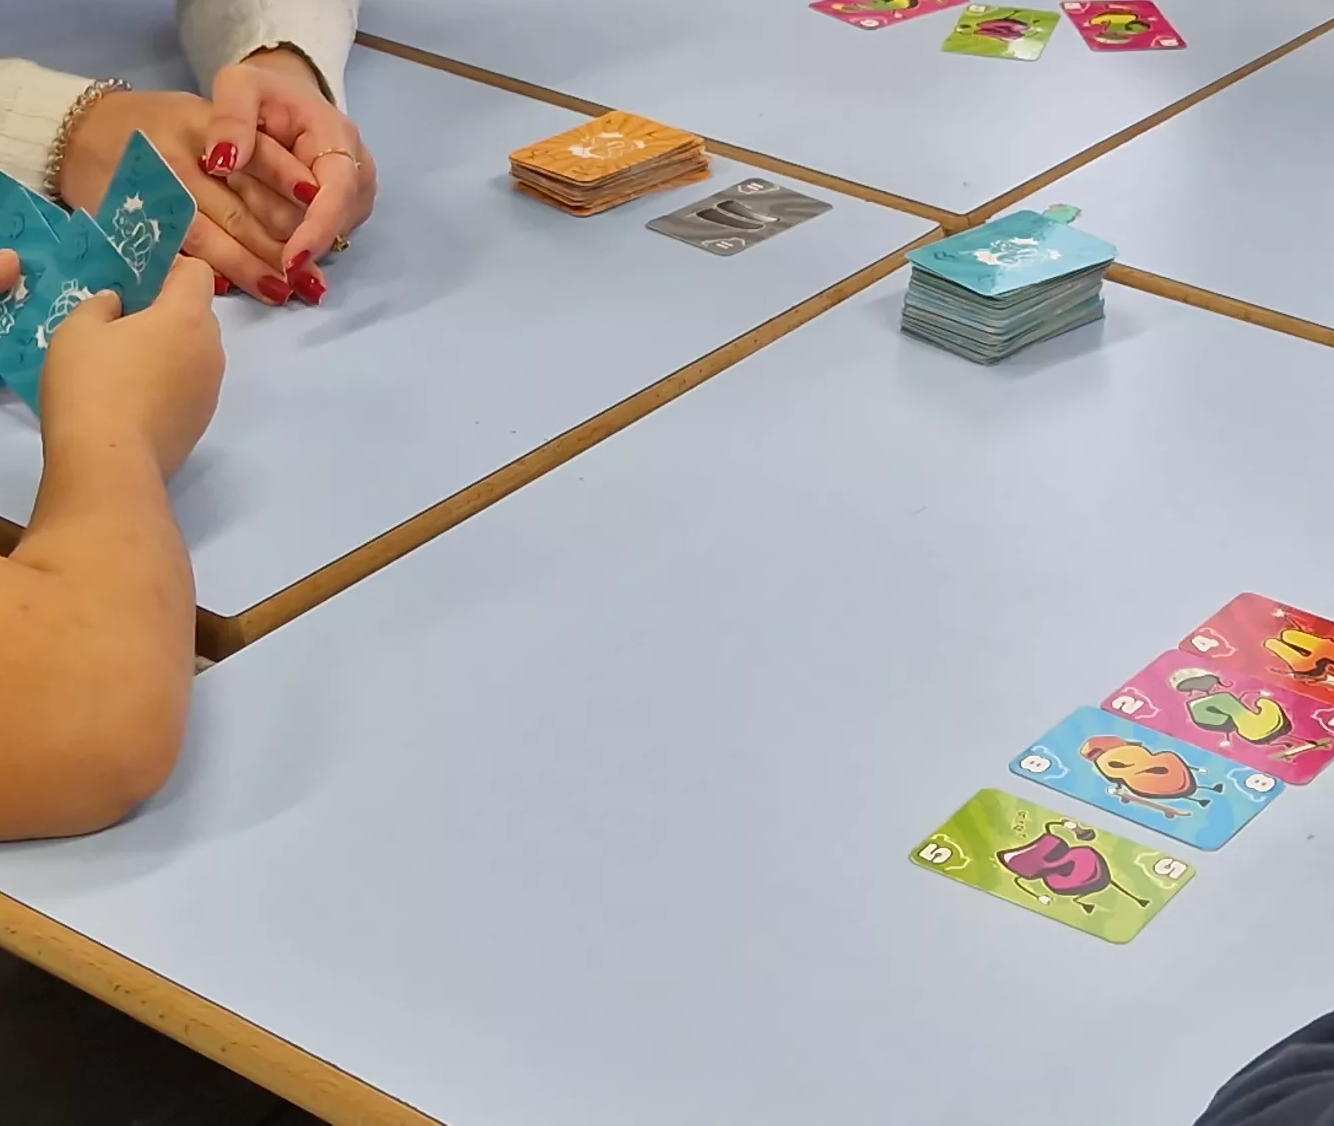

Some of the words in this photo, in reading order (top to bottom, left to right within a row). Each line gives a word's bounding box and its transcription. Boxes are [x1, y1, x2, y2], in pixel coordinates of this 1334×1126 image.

[1191, 634, 1218, 653] 4
[1111, 695, 1145, 715] 2
[1019, 754, 1052, 774] 8
[1244, 772, 1278, 793] 8
[917, 842, 954, 865] 5
[1152, 857, 1189, 881] 5
